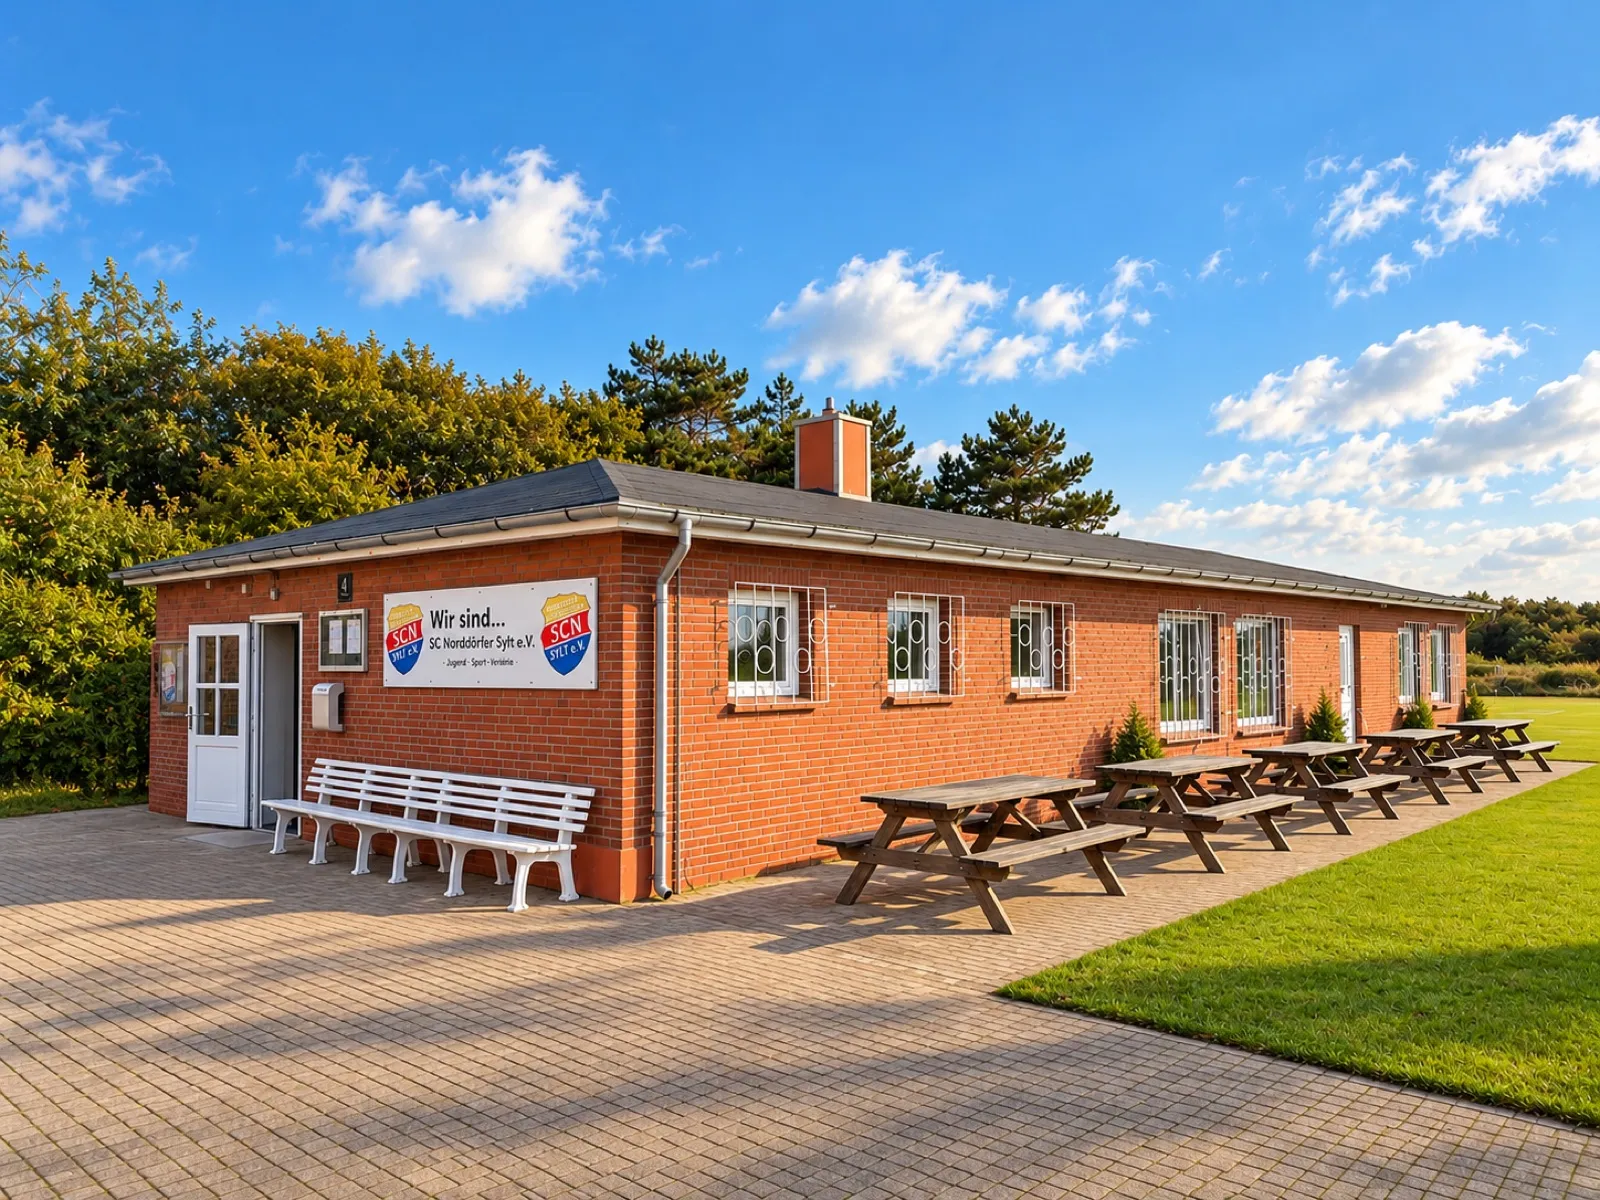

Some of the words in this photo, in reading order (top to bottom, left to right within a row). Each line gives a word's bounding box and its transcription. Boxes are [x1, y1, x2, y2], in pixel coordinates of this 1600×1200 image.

[430, 609, 455, 629] Wir
[459, 606, 506, 628] sind...
[392, 622, 418, 648] SCN
[550, 615, 582, 643] SCN
[429, 637, 441, 650] SC
[443, 635, 494, 649] Norddörfer
[516, 634, 535, 648] e.V.
[550, 644, 568, 660] SYLT
[570, 639, 586, 653] e.V.
[471, 657, 487, 668] Sport
